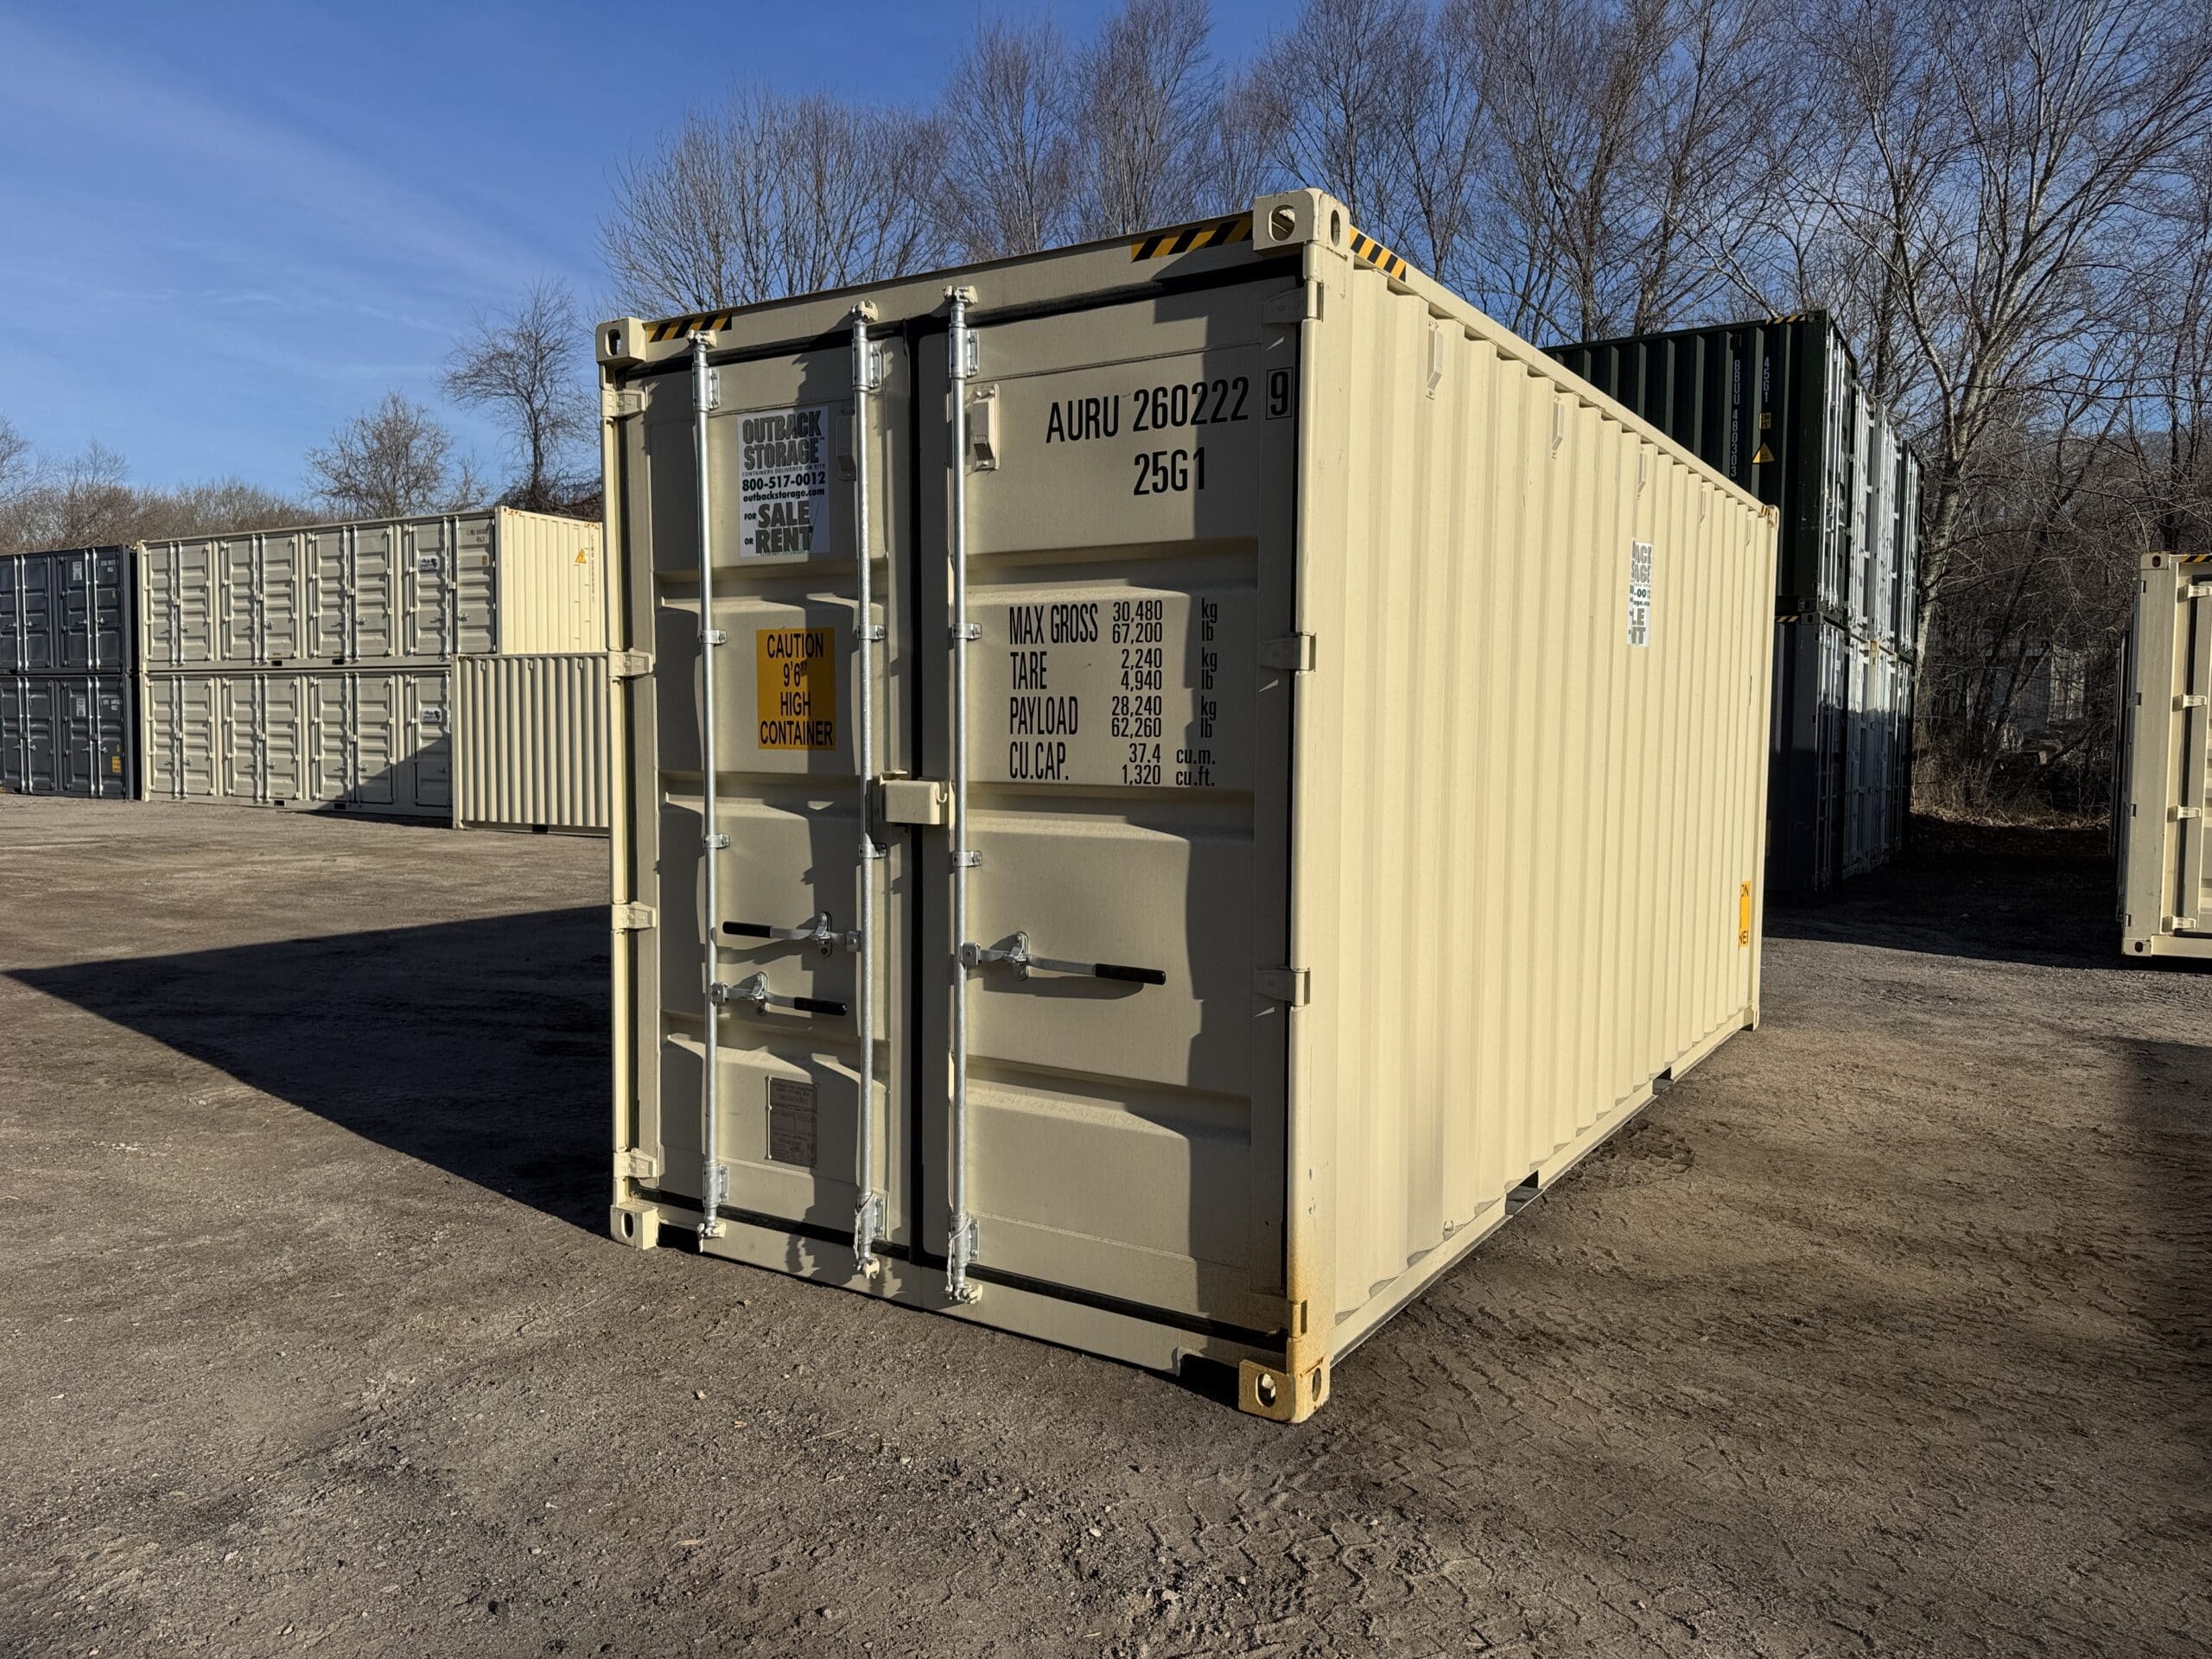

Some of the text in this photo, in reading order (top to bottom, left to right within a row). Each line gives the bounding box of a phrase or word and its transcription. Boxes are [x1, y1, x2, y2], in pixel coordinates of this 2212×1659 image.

[1046, 371, 1289, 444] AURU 260222 9
[742, 410, 822, 444] OUTBACK
[744, 437, 820, 471] STORAGE
[741, 468, 773, 478] CONTAINERS
[774, 466, 803, 474] DELIVERED
[741, 471, 826, 492] 800-517-0012
[1133, 447, 1205, 496] 25G1
[743, 488, 825, 502] outbackstorage.com
[758, 500, 810, 529] SALE
[755, 525, 813, 554] RENT
[1009, 598, 1218, 645] MAX GROSS 30,480 kg
[1112, 622, 1214, 645] 67,200 lb
[766, 632, 823, 658] CAUTION
[1010, 646, 1218, 690] TARE 2,240 kg
[1121, 670, 1214, 692] 4,940 lb
[780, 691, 811, 716] HIGH
[1009, 695, 1217, 735] PAYLOAD 28,240 kg
[760, 720, 834, 747] CONTAINER
[1111, 717, 1213, 739] 62,260 lb
[1009, 741, 1216, 781] CU.CAP. 37.4 cu.m.
[1122, 765, 1216, 787] 1,320 cu.ft.
